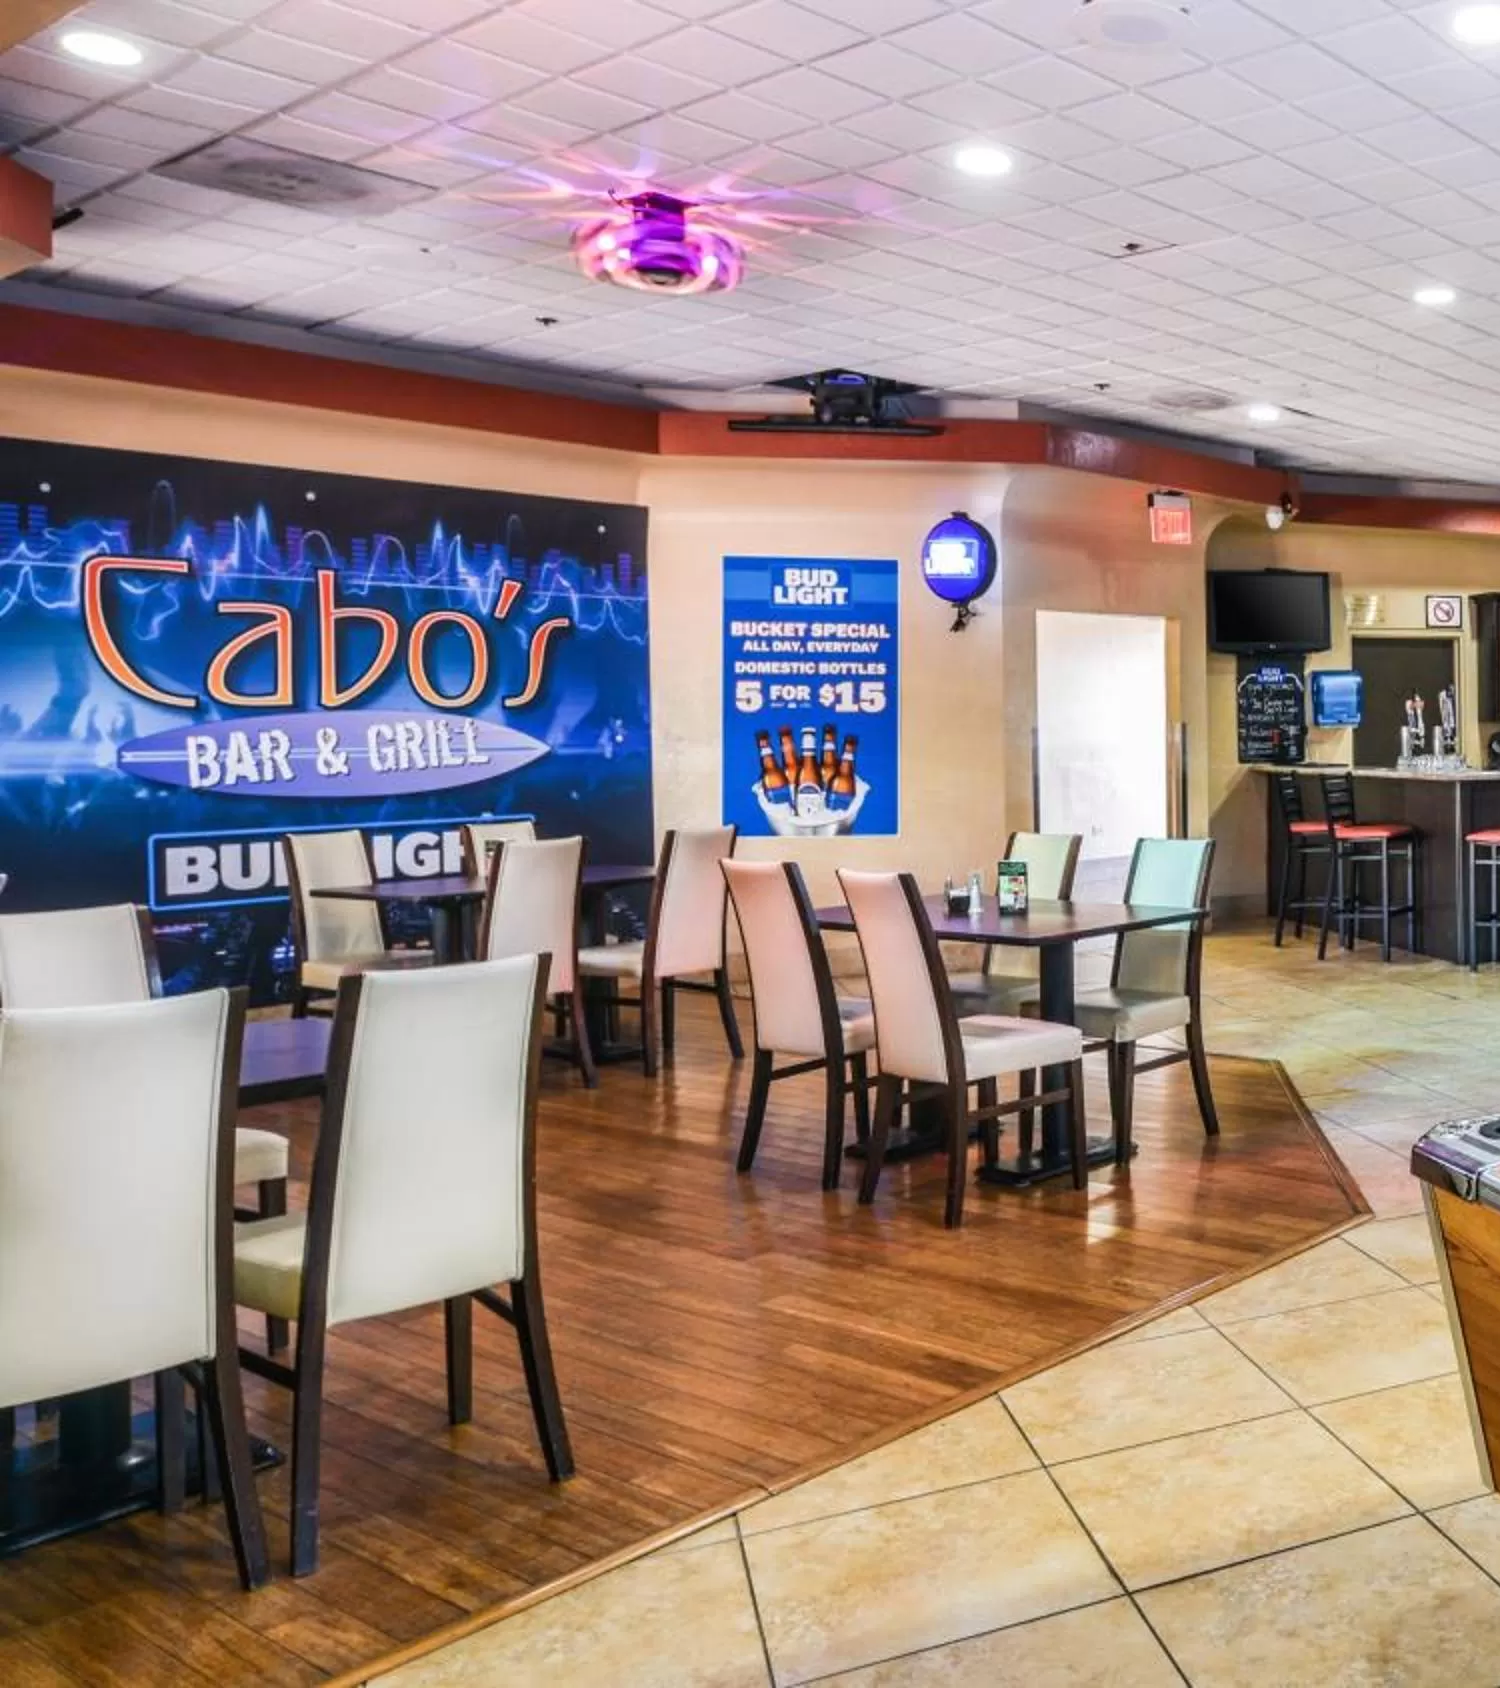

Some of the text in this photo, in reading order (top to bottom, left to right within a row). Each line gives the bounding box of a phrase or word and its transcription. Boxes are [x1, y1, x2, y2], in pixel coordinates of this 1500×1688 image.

[784, 568, 838, 586] BUD
[773, 586, 848, 604] LIGHT
[83, 556, 570, 709] Cabo's
[731, 621, 890, 639] BUCKET SPECIAL
[743, 640, 879, 654] ALL DAY, EVERYDAY
[735, 661, 886, 675] DOMESTIC BOTTLES
[736, 681, 886, 712] 5 FOR $15
[187, 718, 489, 789] BAR & GRILL
